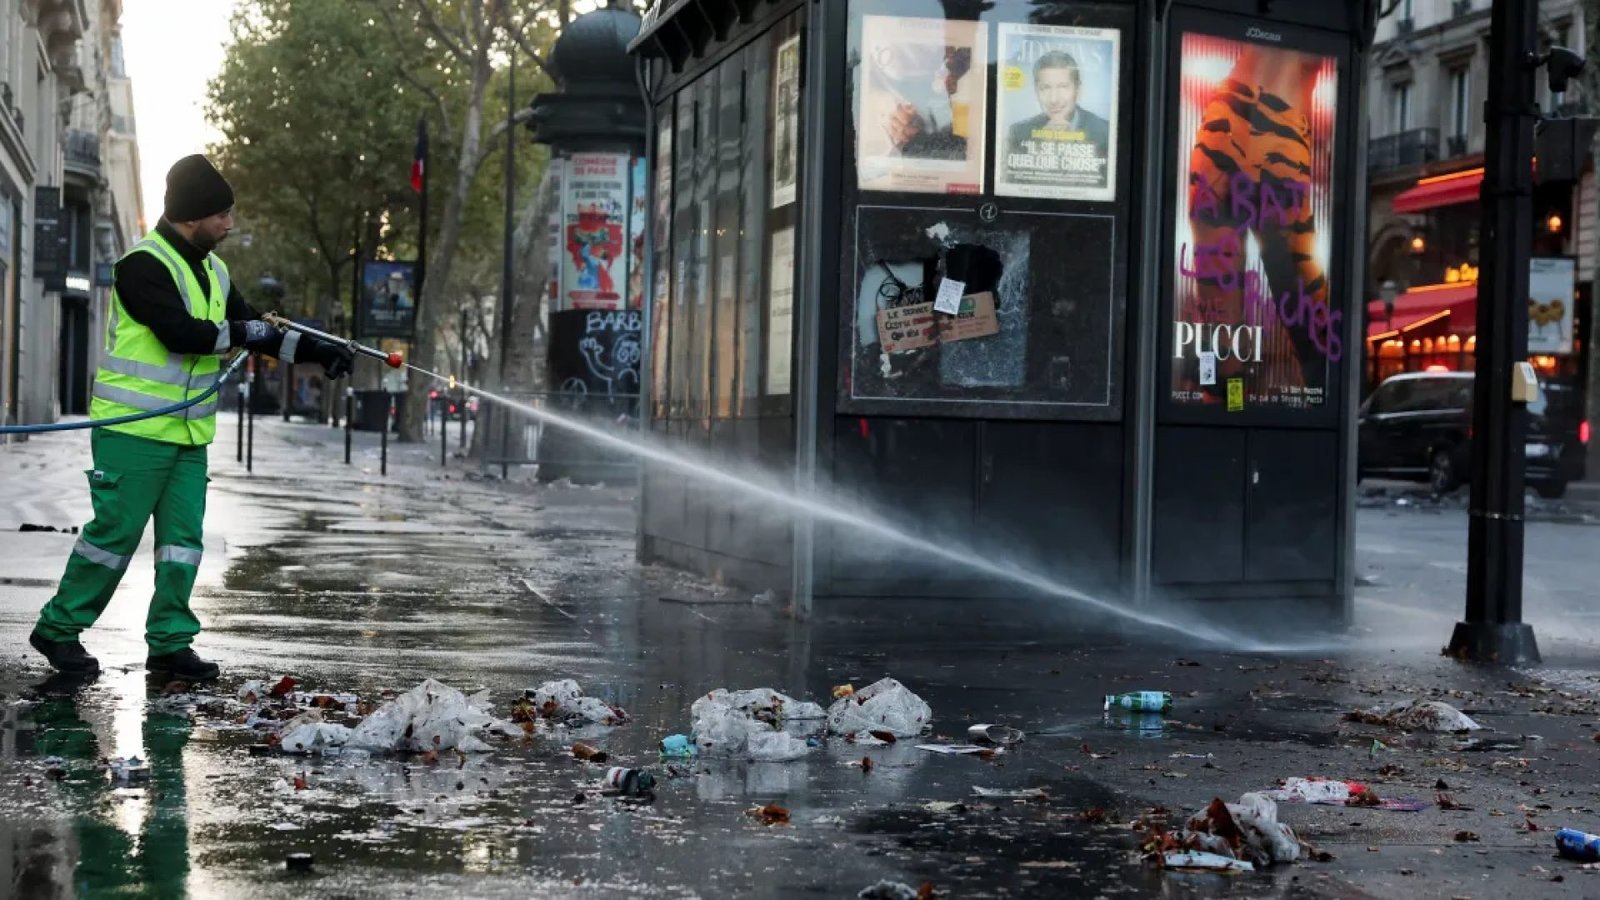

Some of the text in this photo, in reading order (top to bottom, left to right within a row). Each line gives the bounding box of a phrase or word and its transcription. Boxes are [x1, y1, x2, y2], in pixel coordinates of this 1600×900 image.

[1041, 140, 1056, 156] SE
[1058, 142, 1096, 158] PASSE
[1008, 153, 1059, 169] QUELQUE
[1173, 320, 1264, 362] PUCCI
